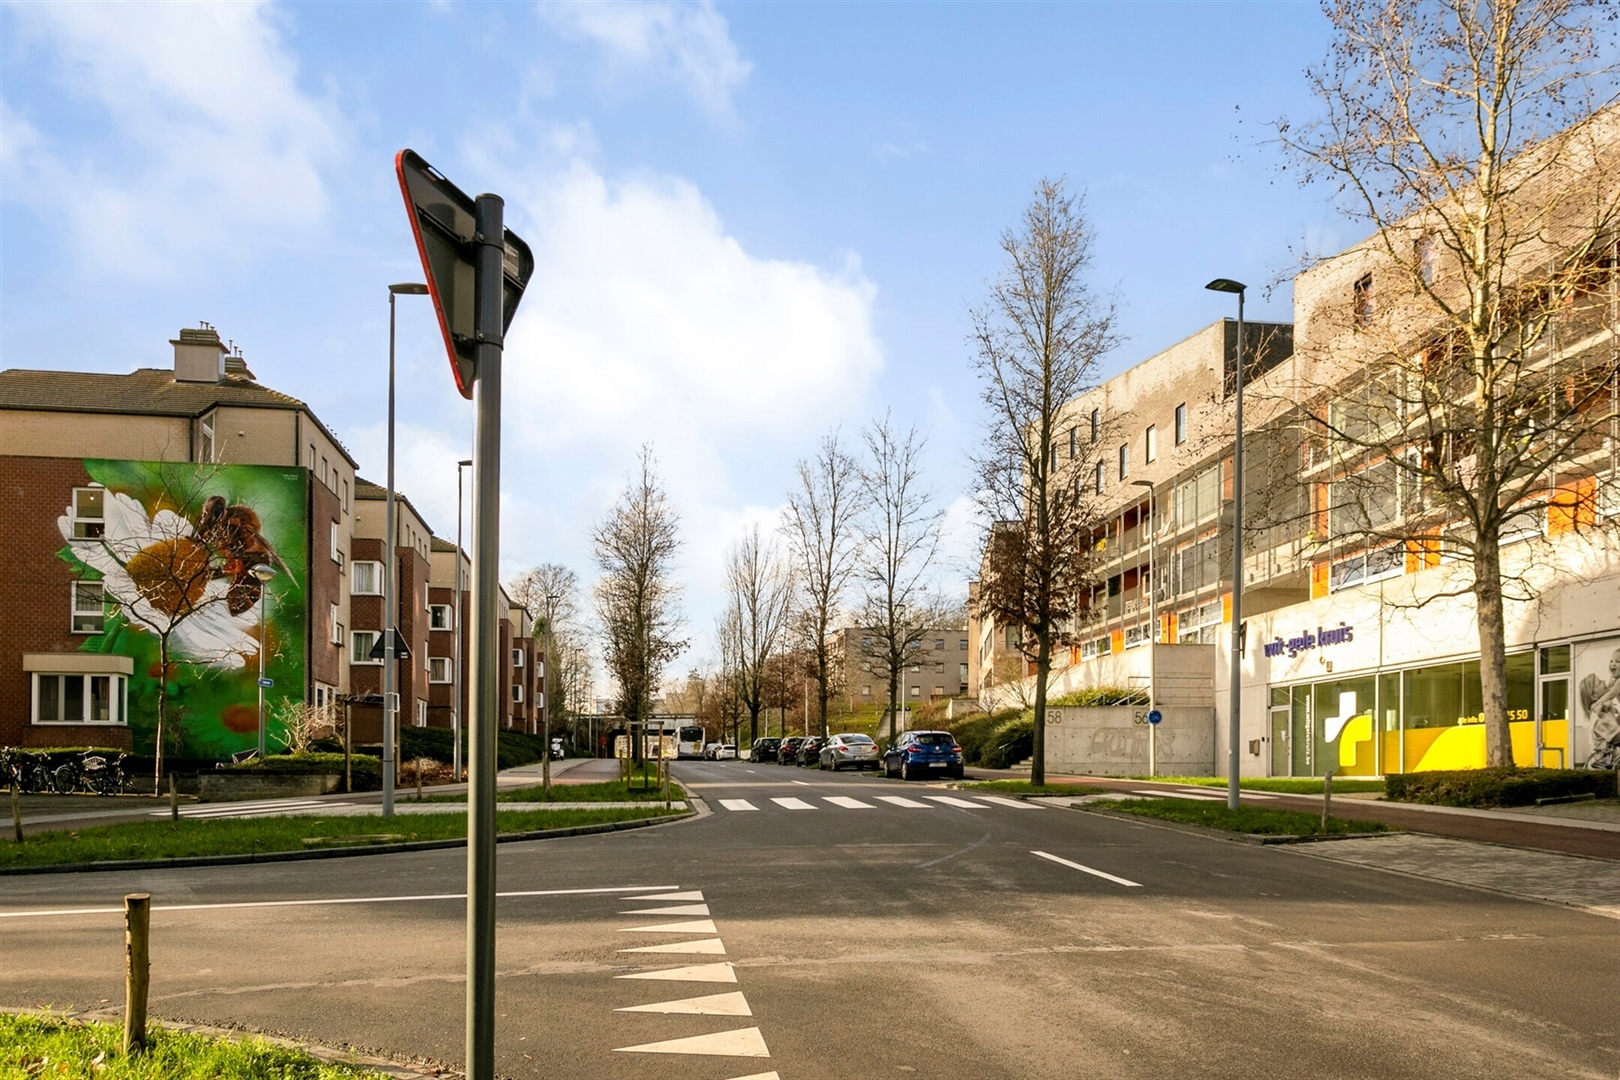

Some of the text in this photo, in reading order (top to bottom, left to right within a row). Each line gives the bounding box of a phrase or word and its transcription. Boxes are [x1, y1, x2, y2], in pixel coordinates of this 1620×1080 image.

[1317, 621, 1354, 647] kruis
[1047, 710, 1062, 724] 58
[1134, 711, 1149, 724] 56
[1516, 709, 1528, 720] 50
